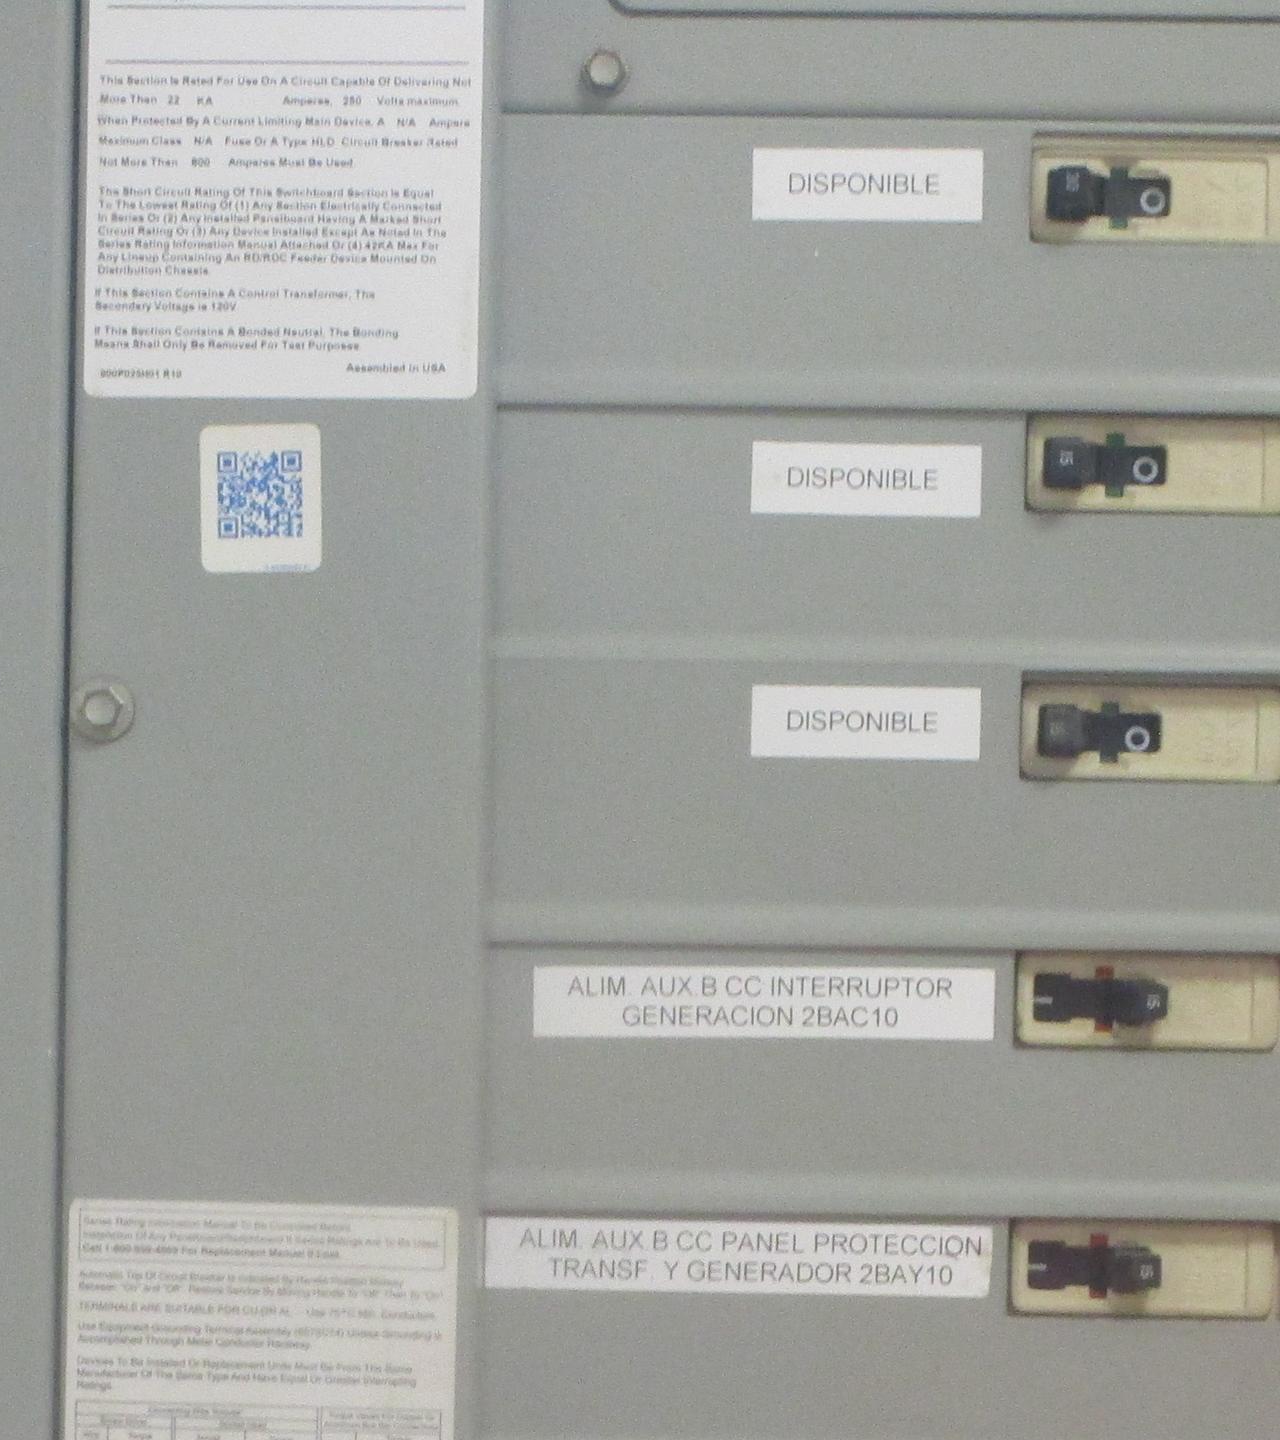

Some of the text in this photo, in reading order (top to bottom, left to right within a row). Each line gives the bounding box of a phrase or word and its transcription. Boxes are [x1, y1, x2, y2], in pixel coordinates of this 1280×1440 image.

[787, 172, 941, 197] DISPONIBLE
[786, 466, 939, 492] DISPONIBLE
[786, 710, 939, 734] DISPONIBLE
[725, 976, 761, 997] CC
[771, 976, 953, 998] INTERRUPTOR
[622, 1005, 898, 1028] GENERACION 2BAC10
[676, 1230, 713, 1251] CC
[722, 1231, 804, 1252] PANEL
[814, 1233, 982, 1256] PROTECCION
[664, 1260, 679, 1281] Y
[687, 1260, 851, 1283] GENERADOR
[859, 1263, 953, 1286] 2BAY10
